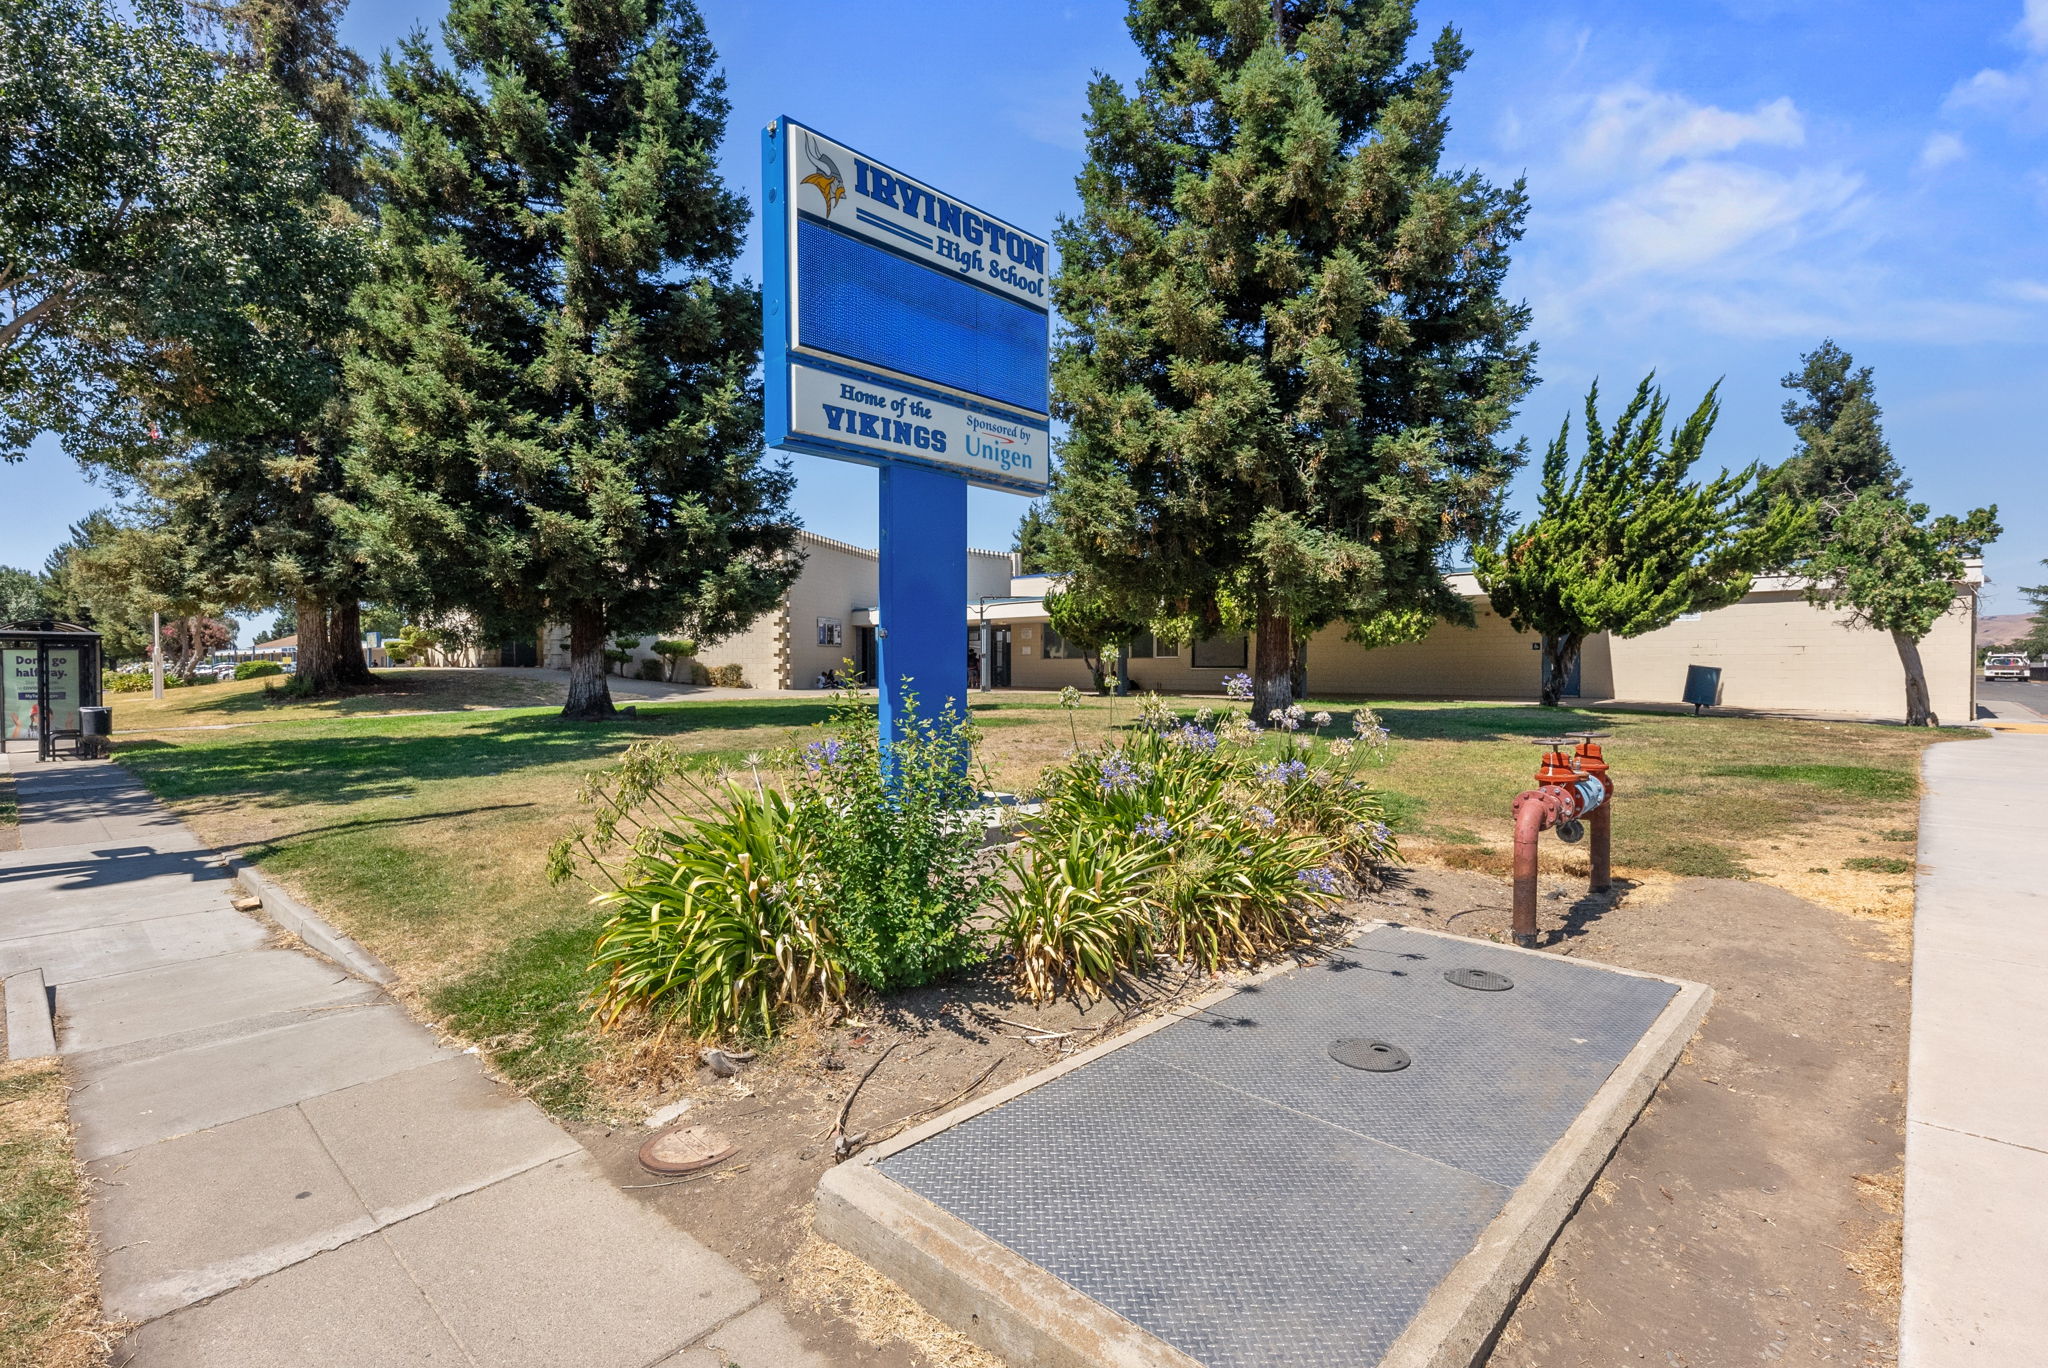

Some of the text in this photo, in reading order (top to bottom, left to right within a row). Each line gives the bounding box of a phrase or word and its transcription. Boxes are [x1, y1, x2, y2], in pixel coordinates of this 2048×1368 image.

[853, 158, 1045, 275] IRVINGTON
[936, 235, 1045, 298] High School
[840, 383, 932, 420] Home of the
[822, 403, 947, 454] VIKINGS
[966, 415, 1031, 445] Sponsored by
[965, 434, 1033, 471] Unigen
[16, 667, 68, 680] halfay.
[52, 657, 66, 667] go
